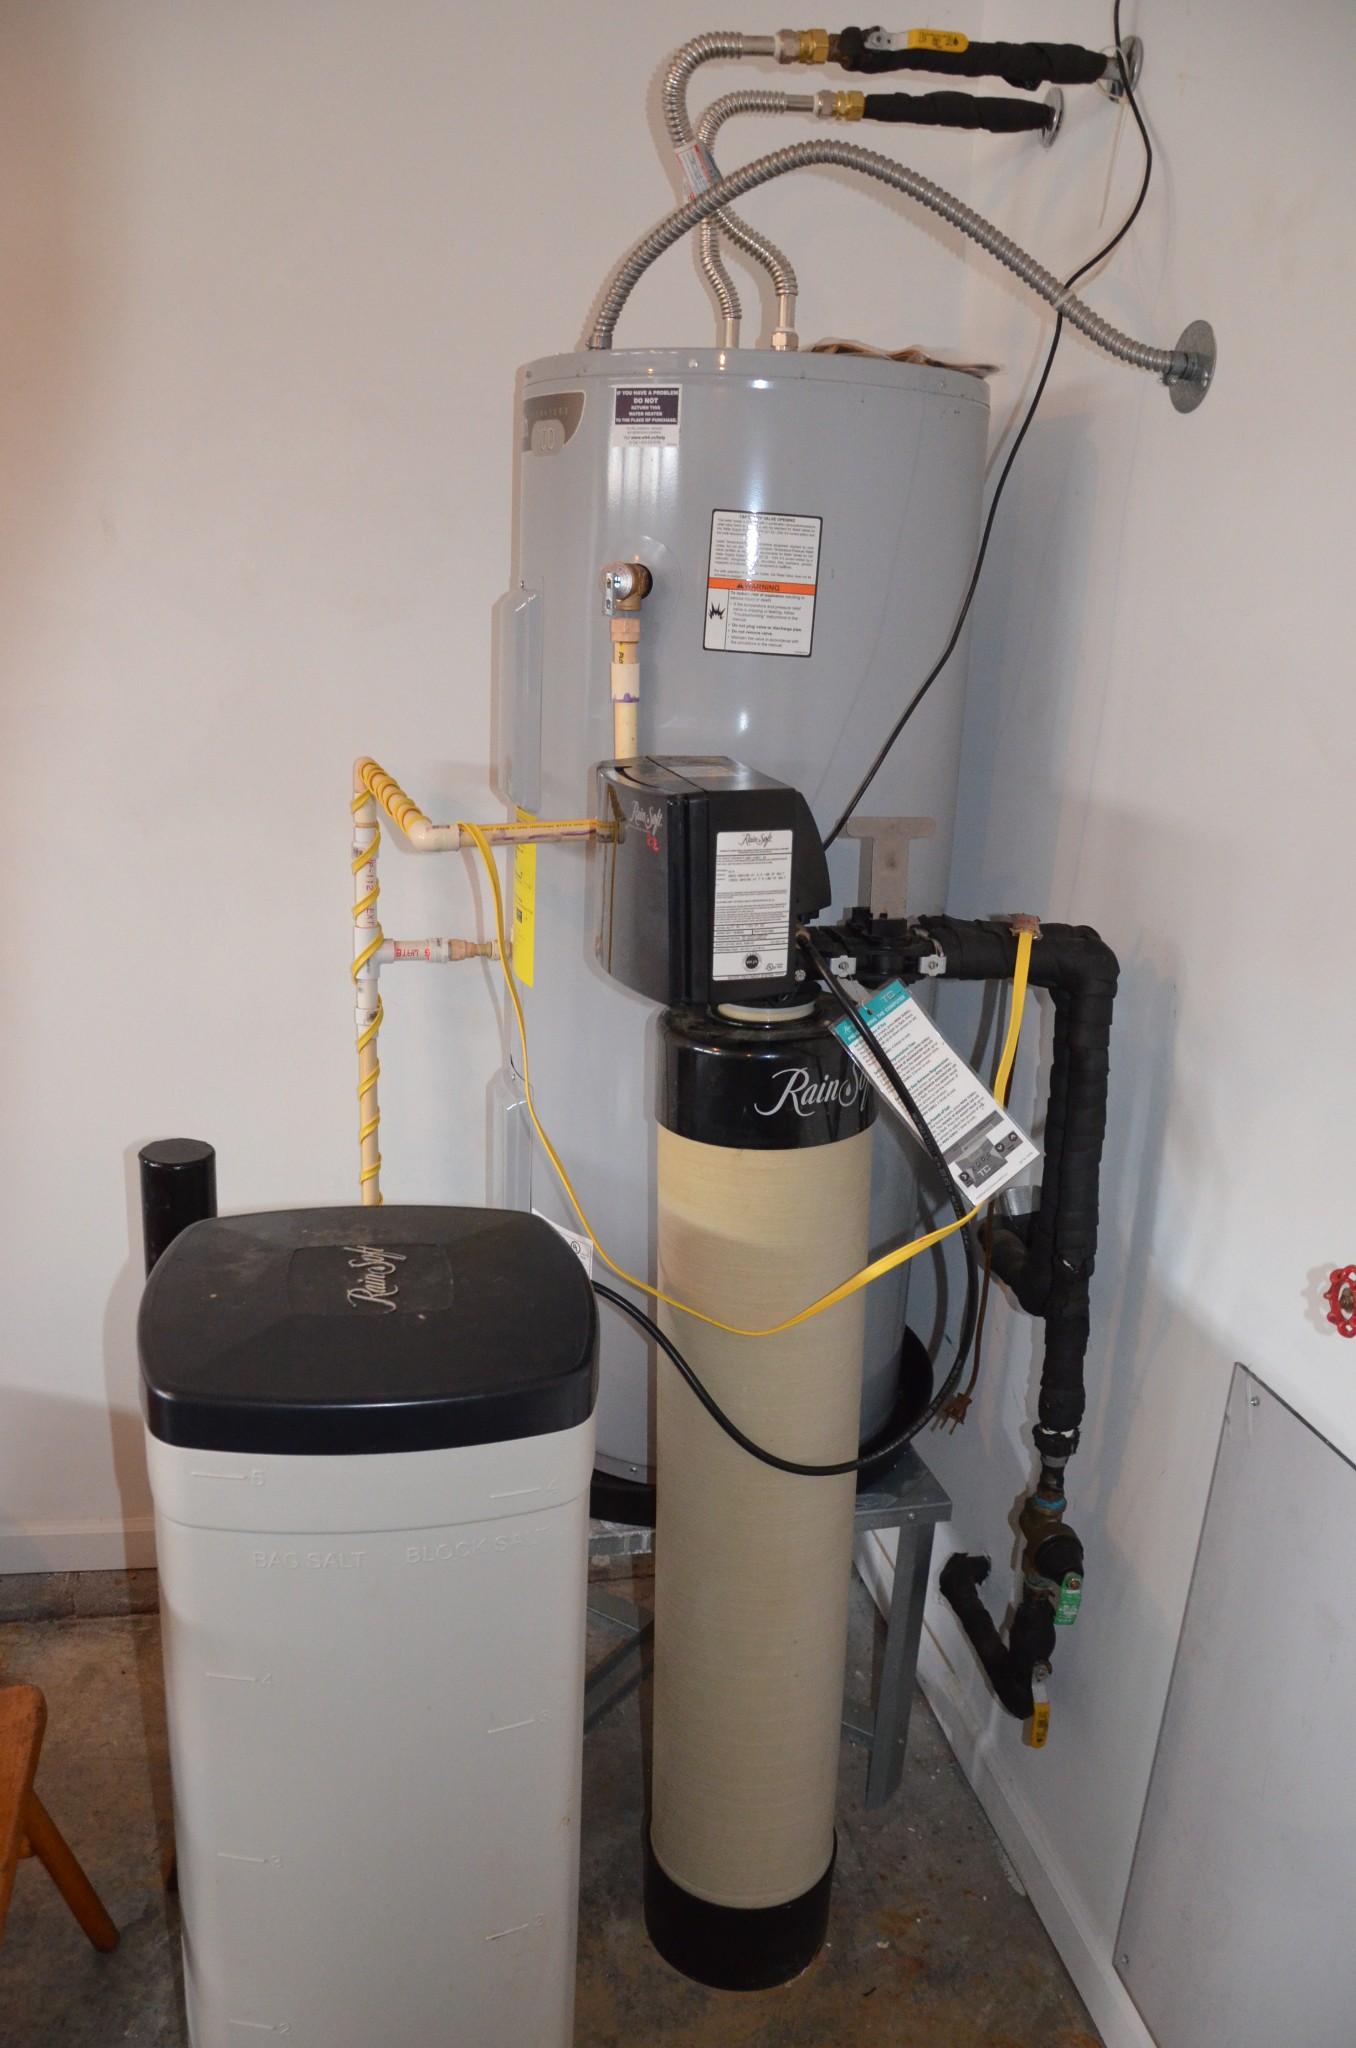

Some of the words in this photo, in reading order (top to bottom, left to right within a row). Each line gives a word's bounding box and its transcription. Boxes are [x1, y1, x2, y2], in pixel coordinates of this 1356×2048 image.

[251, 1470, 266, 1487] 5
[406, 1537, 486, 1563] BLOCK
[253, 1551, 298, 1569] BAG
[306, 1551, 367, 1569] SALT
